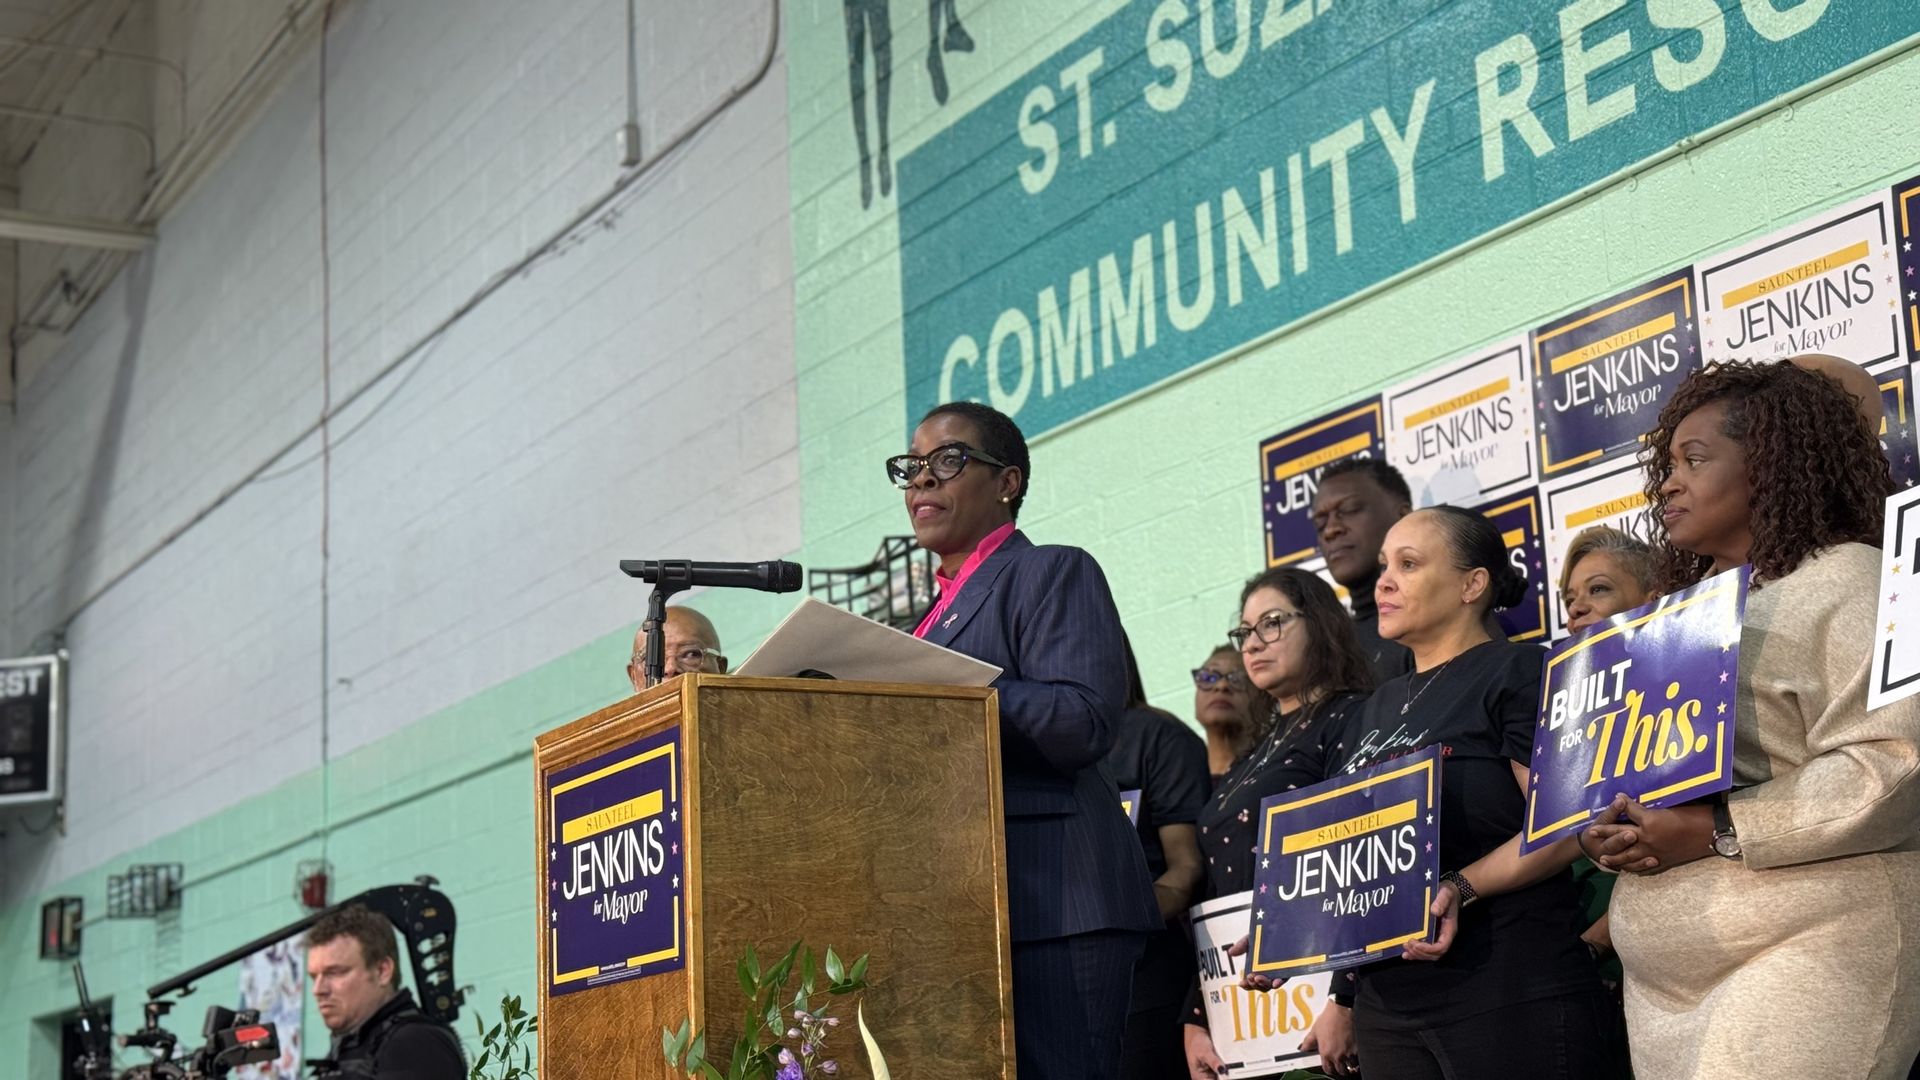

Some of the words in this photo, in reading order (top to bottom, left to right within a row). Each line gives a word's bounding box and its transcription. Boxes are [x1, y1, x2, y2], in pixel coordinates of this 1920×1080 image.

[1017, 46, 1117, 194] ST.
[1143, 0, 1334, 113] SU
[938, 77, 1436, 419] COMMUNITY
[1758, 258, 1832, 294] SAUNTEEL
[1726, 263, 1874, 350] JENKINS
[1581, 329, 1643, 360] SAUNTEEL
[1773, 341, 1786, 354] for
[1787, 318, 1853, 355] Mayor
[1554, 333, 1679, 412] JENKINS
[1605, 384, 1662, 418] Mayor
[1406, 396, 1513, 465] JENKINS
[1595, 494, 1652, 519] SAUNTE
[1549, 659, 1632, 731] BUILT
[1559, 731, 1582, 752] FOR
[1584, 681, 1708, 788] This.
[586, 803, 637, 833] SAUNTEEL
[1317, 815, 1383, 842] SAUNTEEL
[563, 818, 664, 900] JENKINS
[1279, 825, 1416, 901] JENKINS
[593, 900, 603, 917] for
[602, 888, 648, 925] Mayor
[1322, 899, 1334, 913] for
[1334, 884, 1395, 918] Mayor
